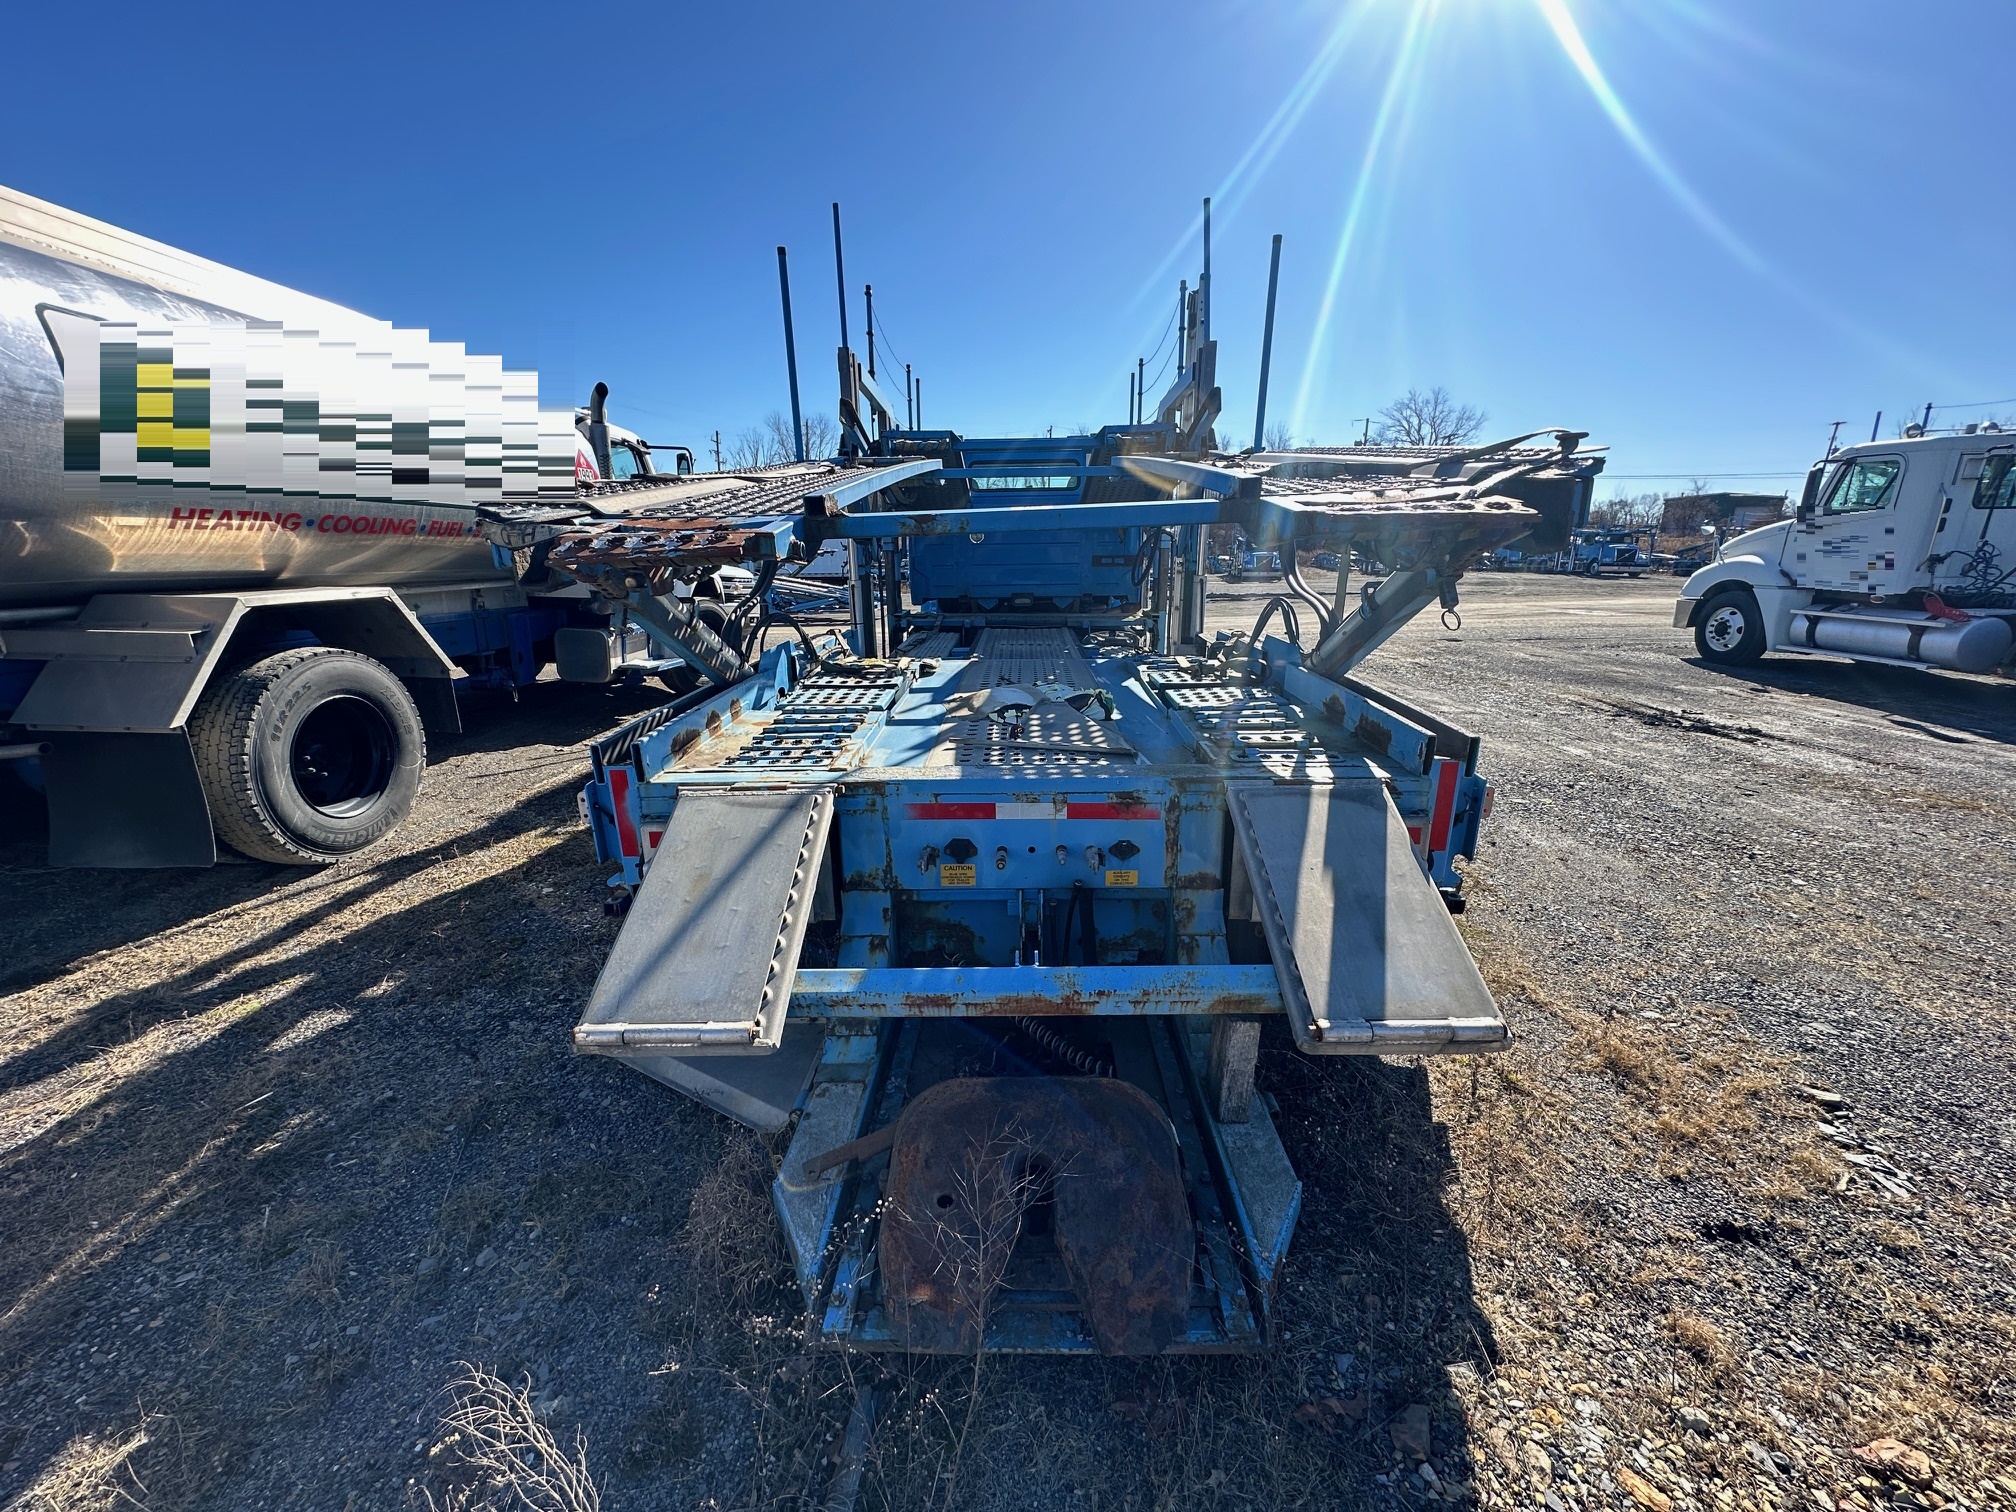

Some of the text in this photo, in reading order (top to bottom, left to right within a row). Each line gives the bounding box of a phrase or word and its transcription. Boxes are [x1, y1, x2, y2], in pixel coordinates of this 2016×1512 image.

[168, 507, 302, 531] HEATING
[317, 514, 417, 536] COOLING
[427, 520, 464, 537] FUEL
[271, 681, 312, 742] 11R22.5
[305, 817, 389, 845] MICHELIN
